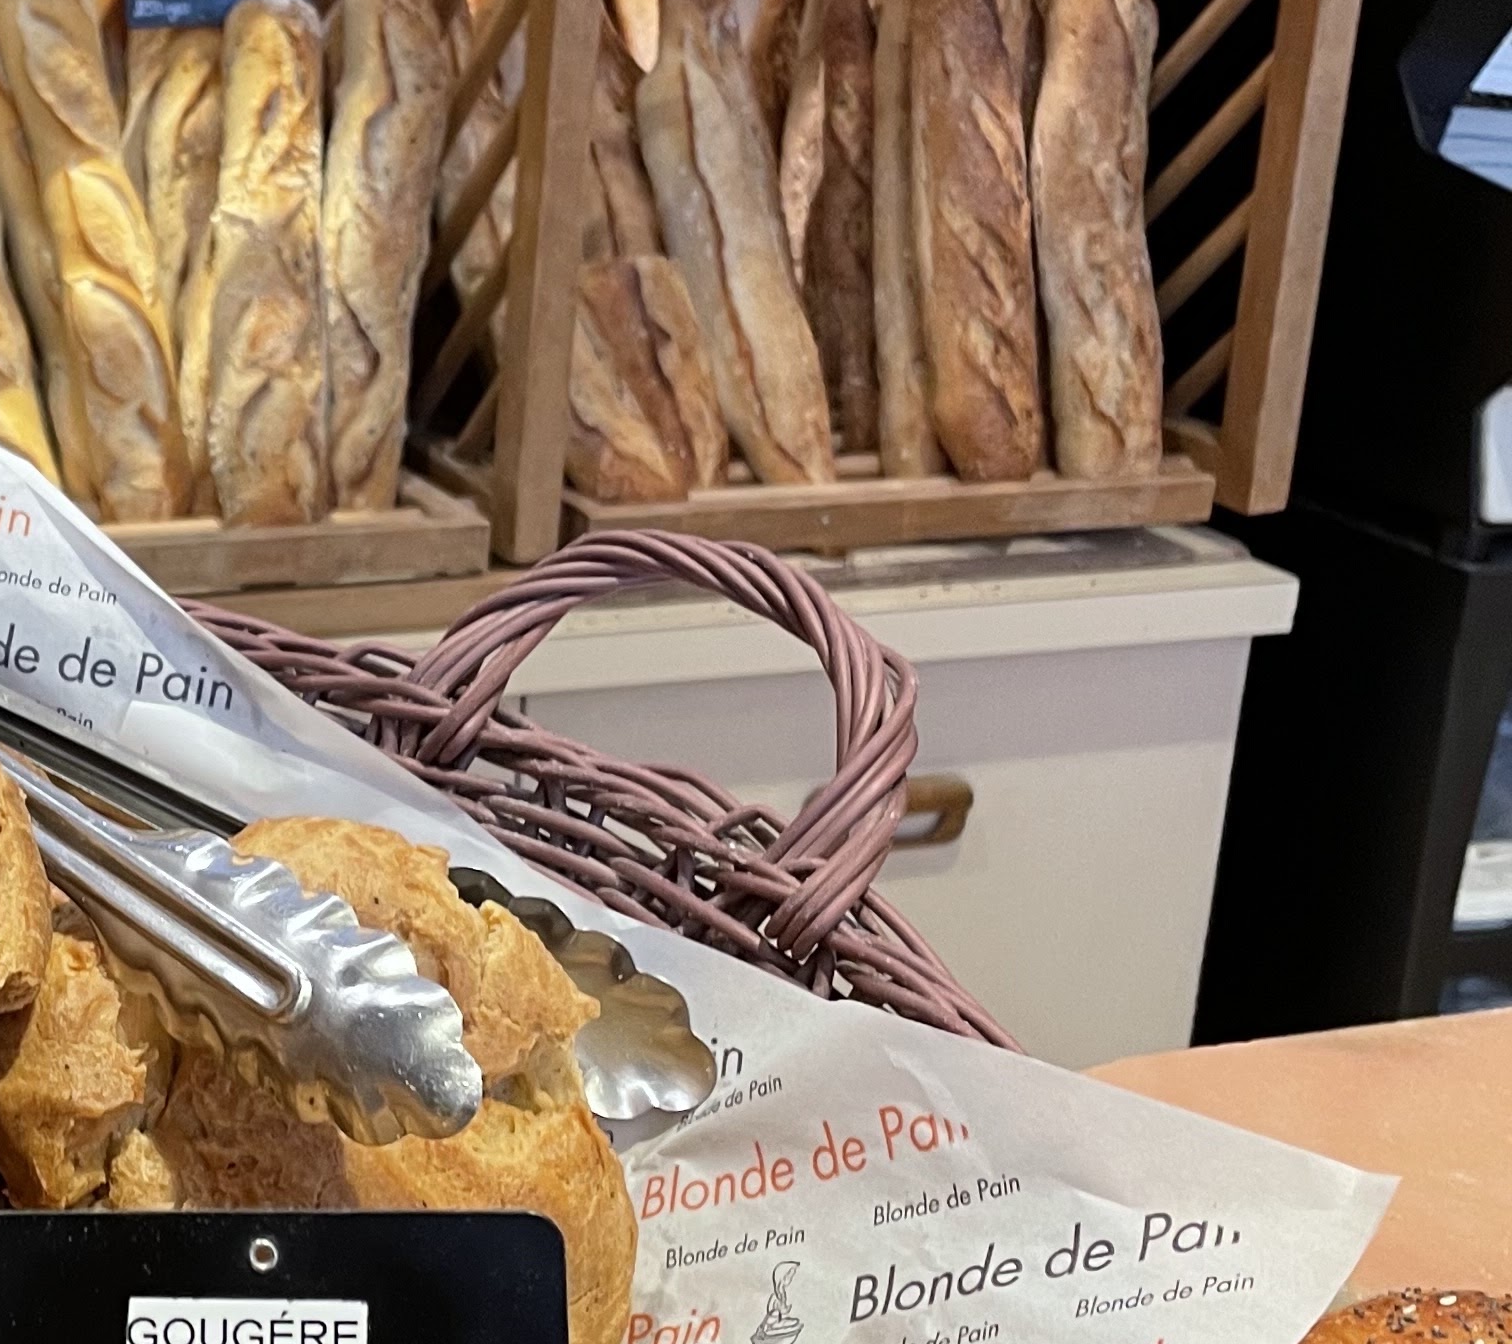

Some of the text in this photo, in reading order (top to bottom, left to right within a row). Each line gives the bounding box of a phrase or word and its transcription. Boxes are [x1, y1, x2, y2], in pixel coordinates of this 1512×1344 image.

[48, 576, 71, 597] de
[78, 581, 117, 605] Pain
[58, 636, 117, 689] de
[135, 651, 234, 710] Pain
[724, 1074, 782, 1109] de Pain
[641, 1105, 969, 1220] Blonde de Pai
[873, 1174, 1021, 1227] Blonde de Pain
[666, 1226, 805, 1269] Blonde de Pain
[849, 1212, 1241, 1324] Blonde de Pa
[1075, 1273, 1254, 1319] Blonde de Pain
